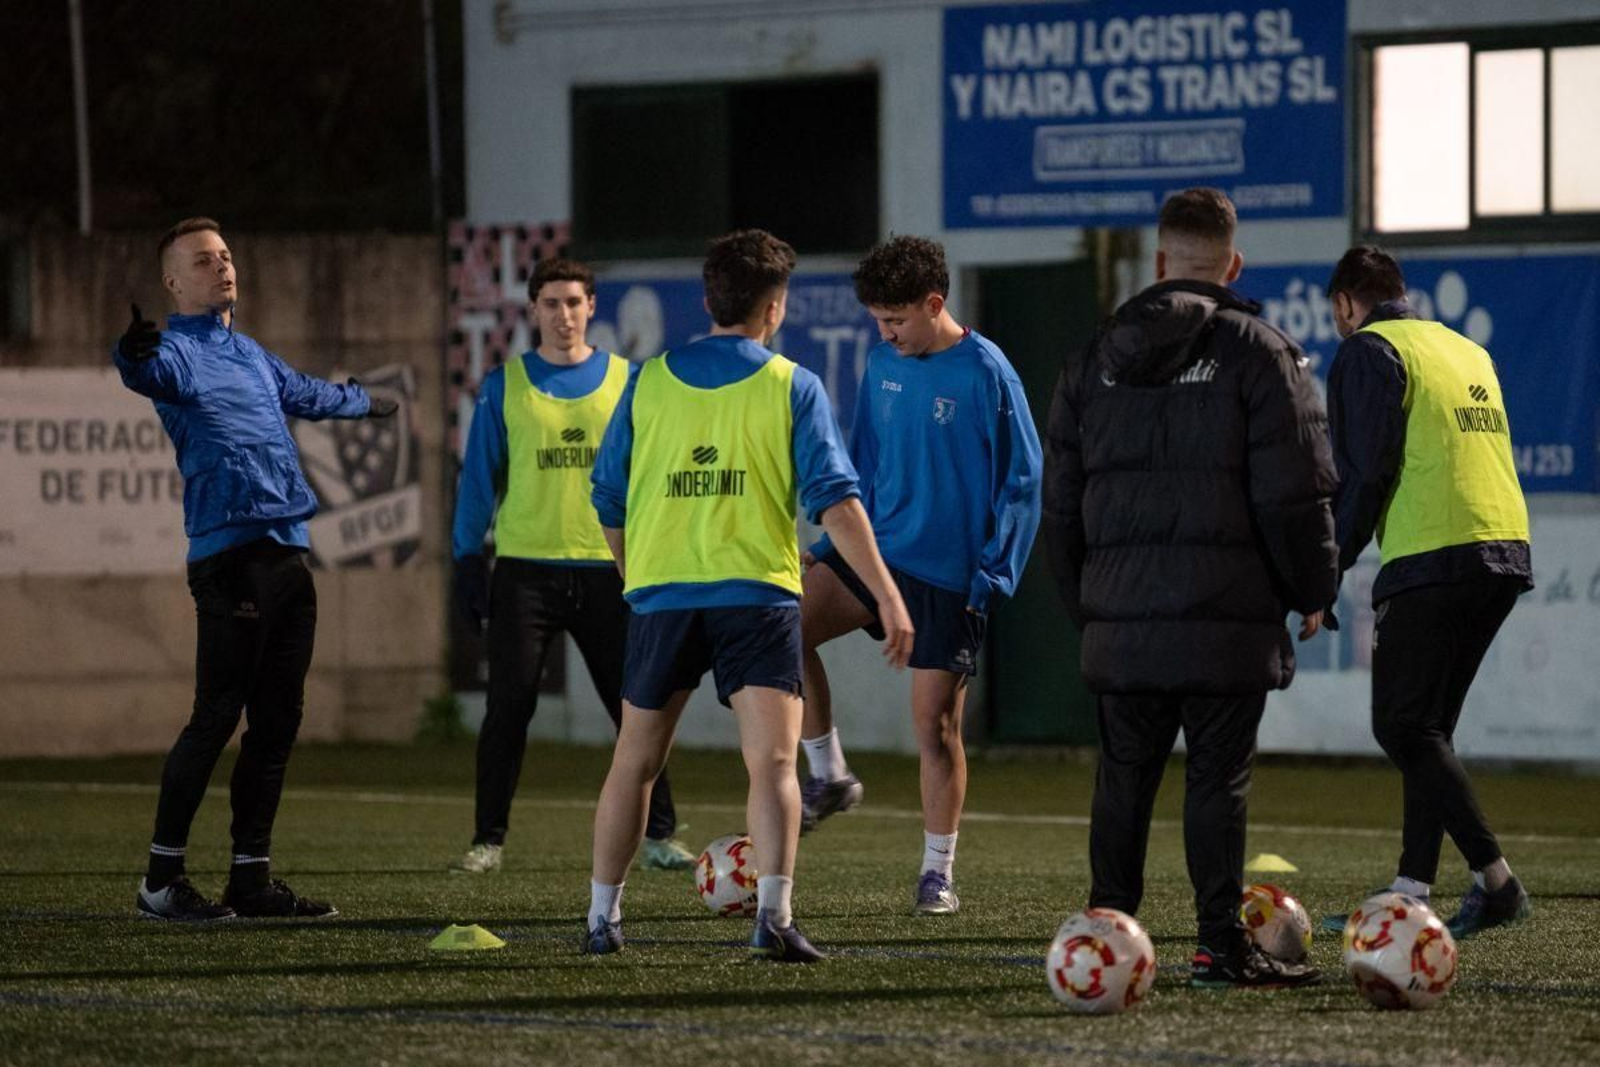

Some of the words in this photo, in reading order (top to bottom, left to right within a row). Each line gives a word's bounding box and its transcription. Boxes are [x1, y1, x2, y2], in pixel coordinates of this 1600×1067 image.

[982, 21, 1076, 68] NAMI
[1083, 11, 1248, 65] LOGISTIC
[1254, 9, 1302, 55] SL
[951, 74, 976, 119] Y
[982, 69, 1097, 118] NAIRA
[1103, 66, 1152, 113] CS
[1158, 62, 1281, 111] TRANS
[1287, 56, 1336, 103] SL
[40, 468, 86, 505] DE
